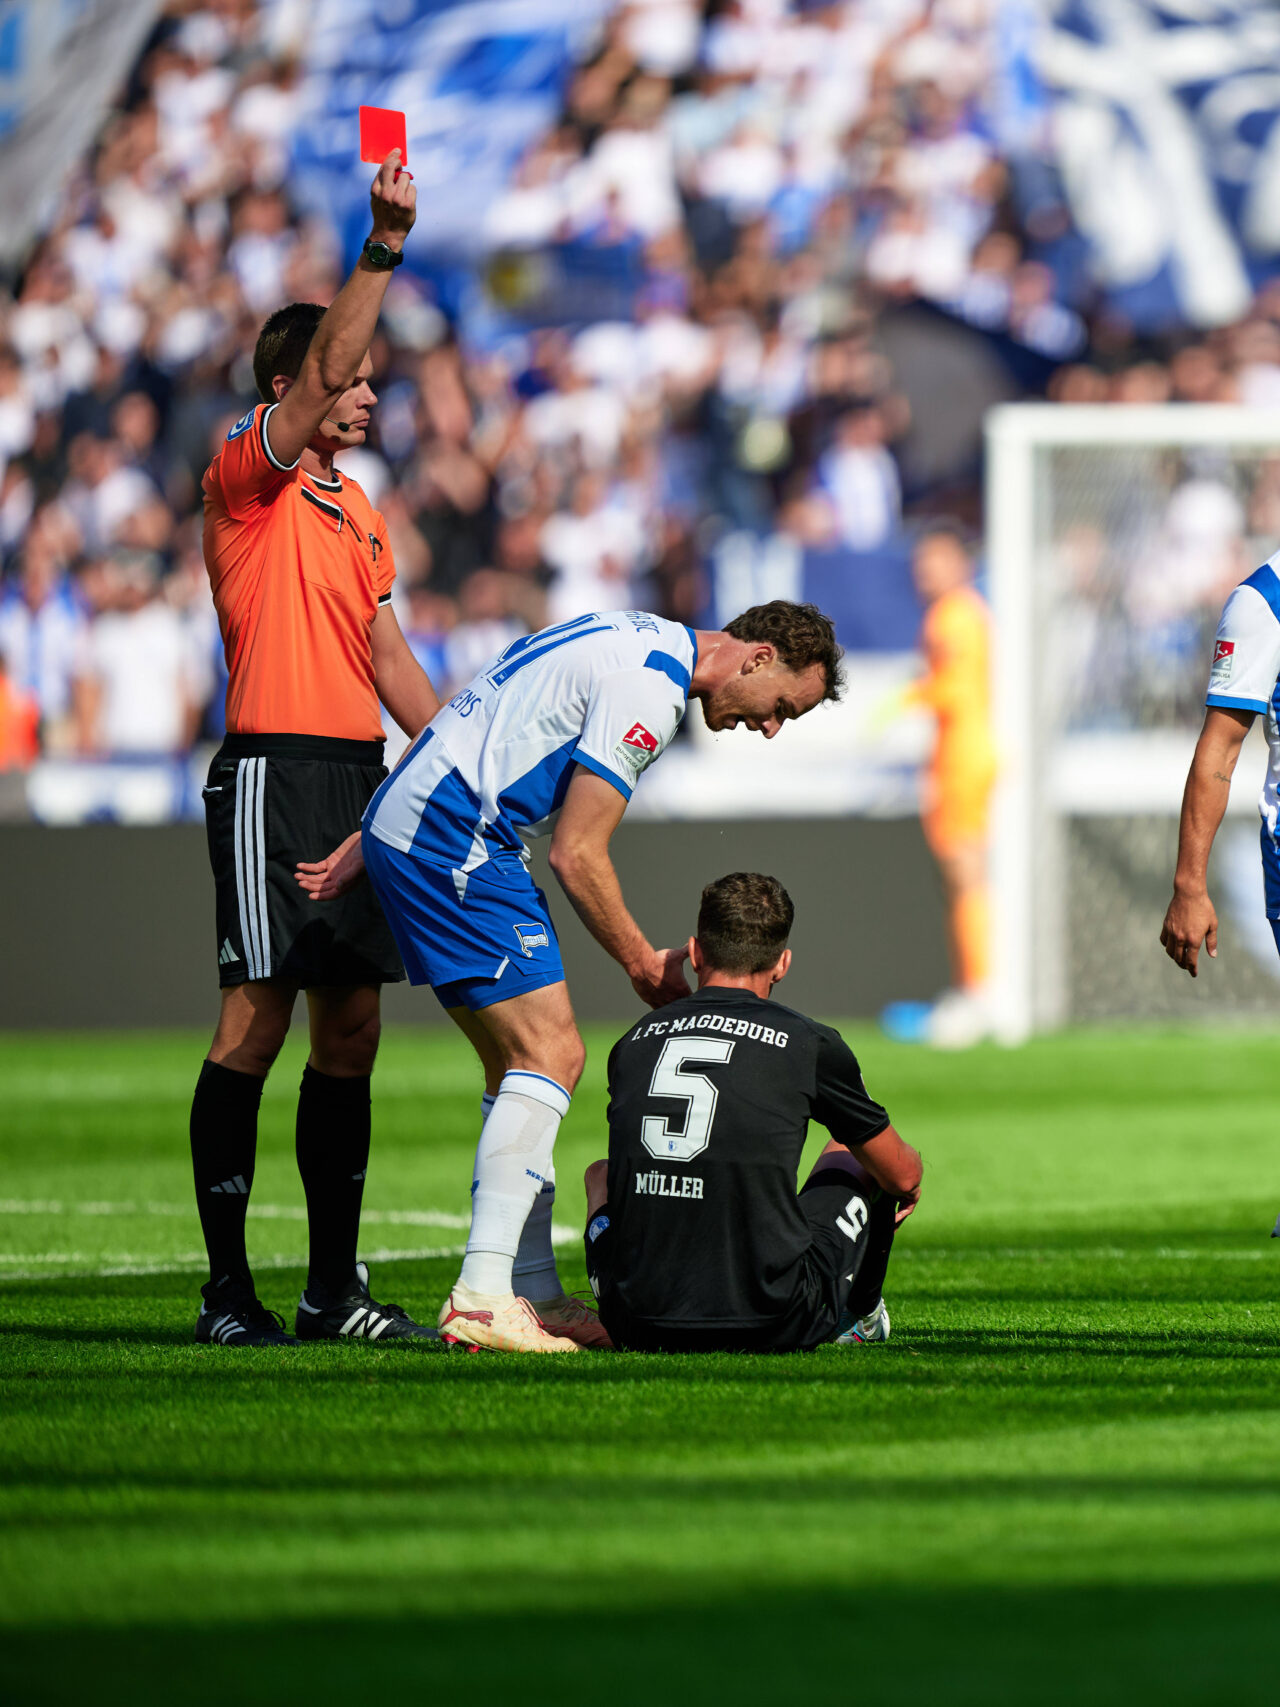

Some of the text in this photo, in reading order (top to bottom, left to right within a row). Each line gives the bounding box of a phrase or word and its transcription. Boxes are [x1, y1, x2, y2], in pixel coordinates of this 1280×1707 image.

[643, 1021, 668, 1038] FC
[668, 1014, 790, 1049] MAGDEBURG
[640, 1035, 736, 1163] 5
[635, 1170, 704, 1200] MÜLLER
[835, 1195, 868, 1244] 5
